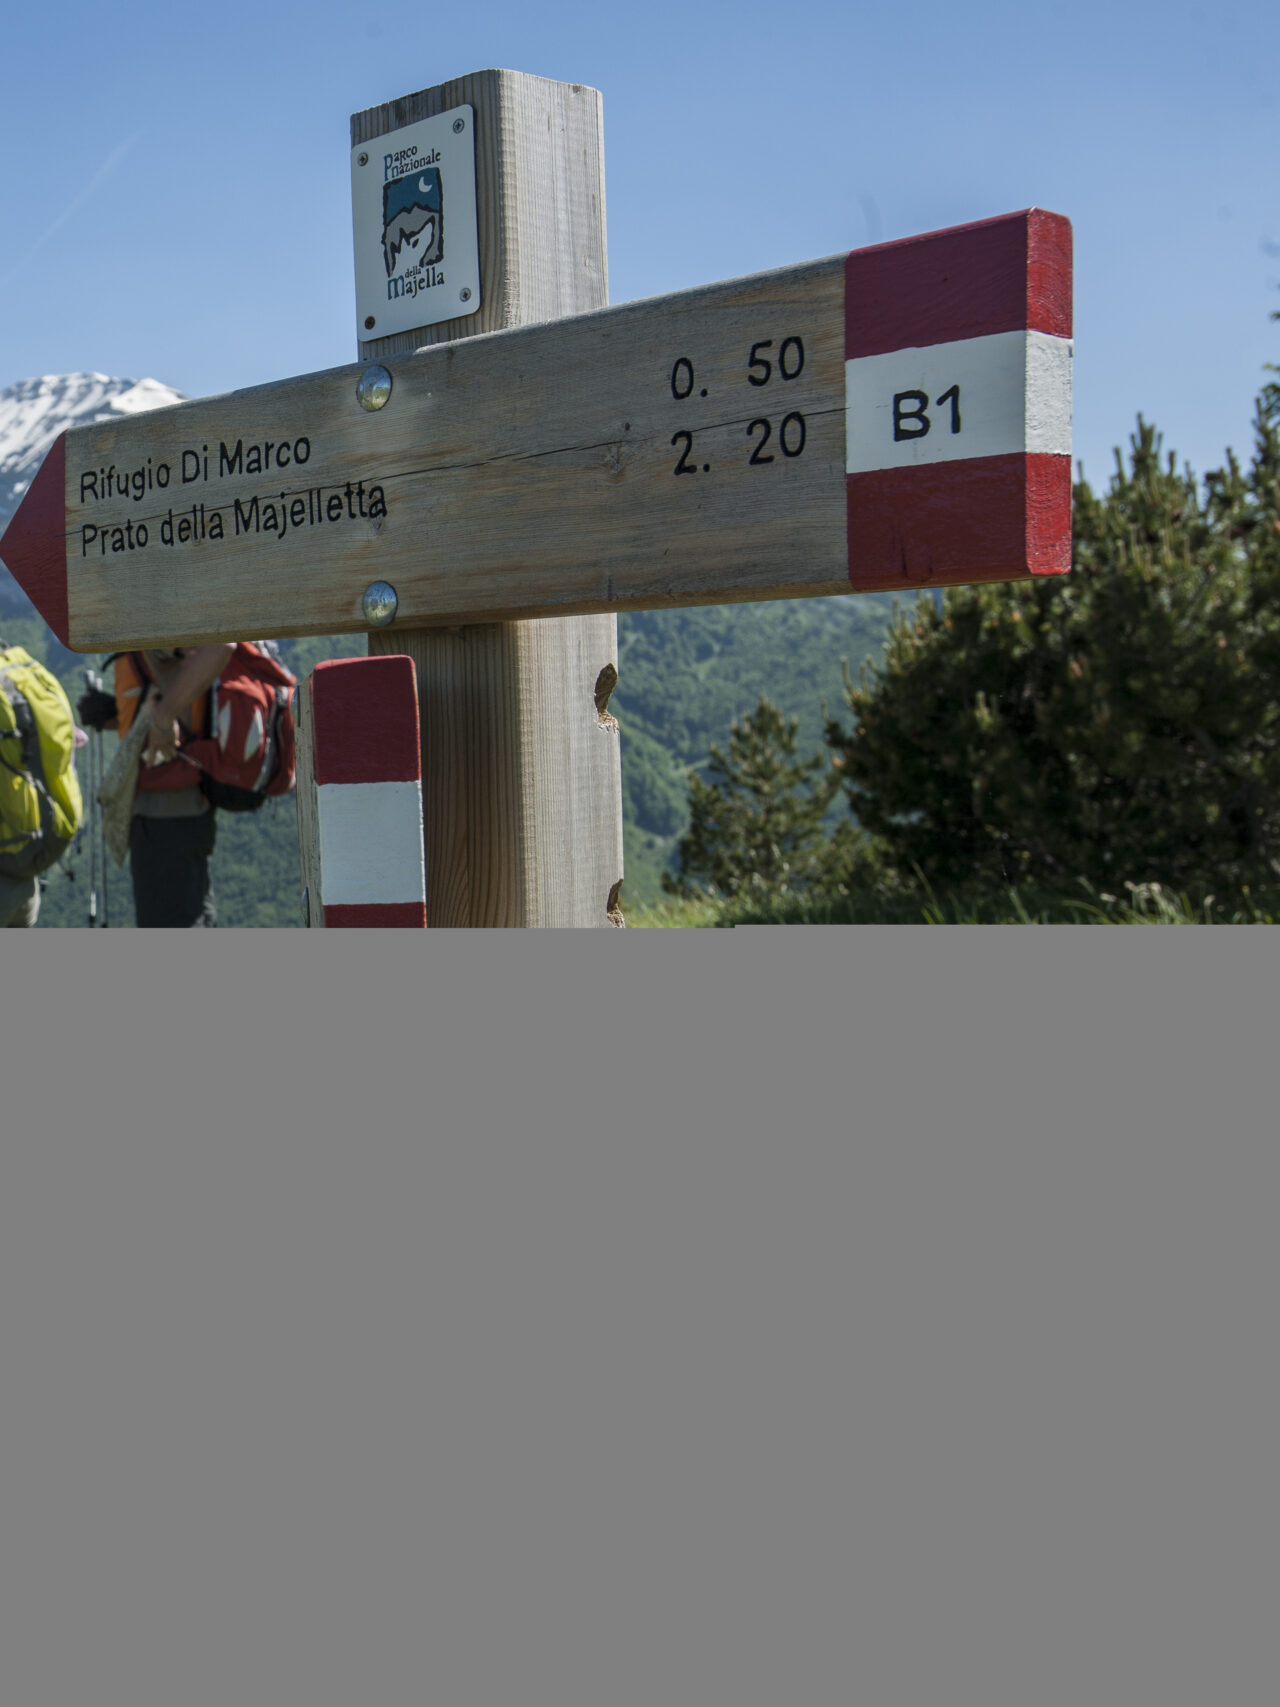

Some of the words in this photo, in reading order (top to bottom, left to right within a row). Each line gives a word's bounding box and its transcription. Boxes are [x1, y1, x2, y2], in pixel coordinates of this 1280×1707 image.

[405, 264, 422, 278] della
[747, 336, 804, 386] 50
[746, 411, 806, 465] 20
[893, 384, 961, 442] B1
[80, 457, 171, 503] Rifugio
[181, 445, 209, 484] Di
[219, 436, 311, 478] Marco
[81, 518, 149, 557] Prato
[160, 503, 224, 547] della
[233, 480, 388, 540] Majelletta
